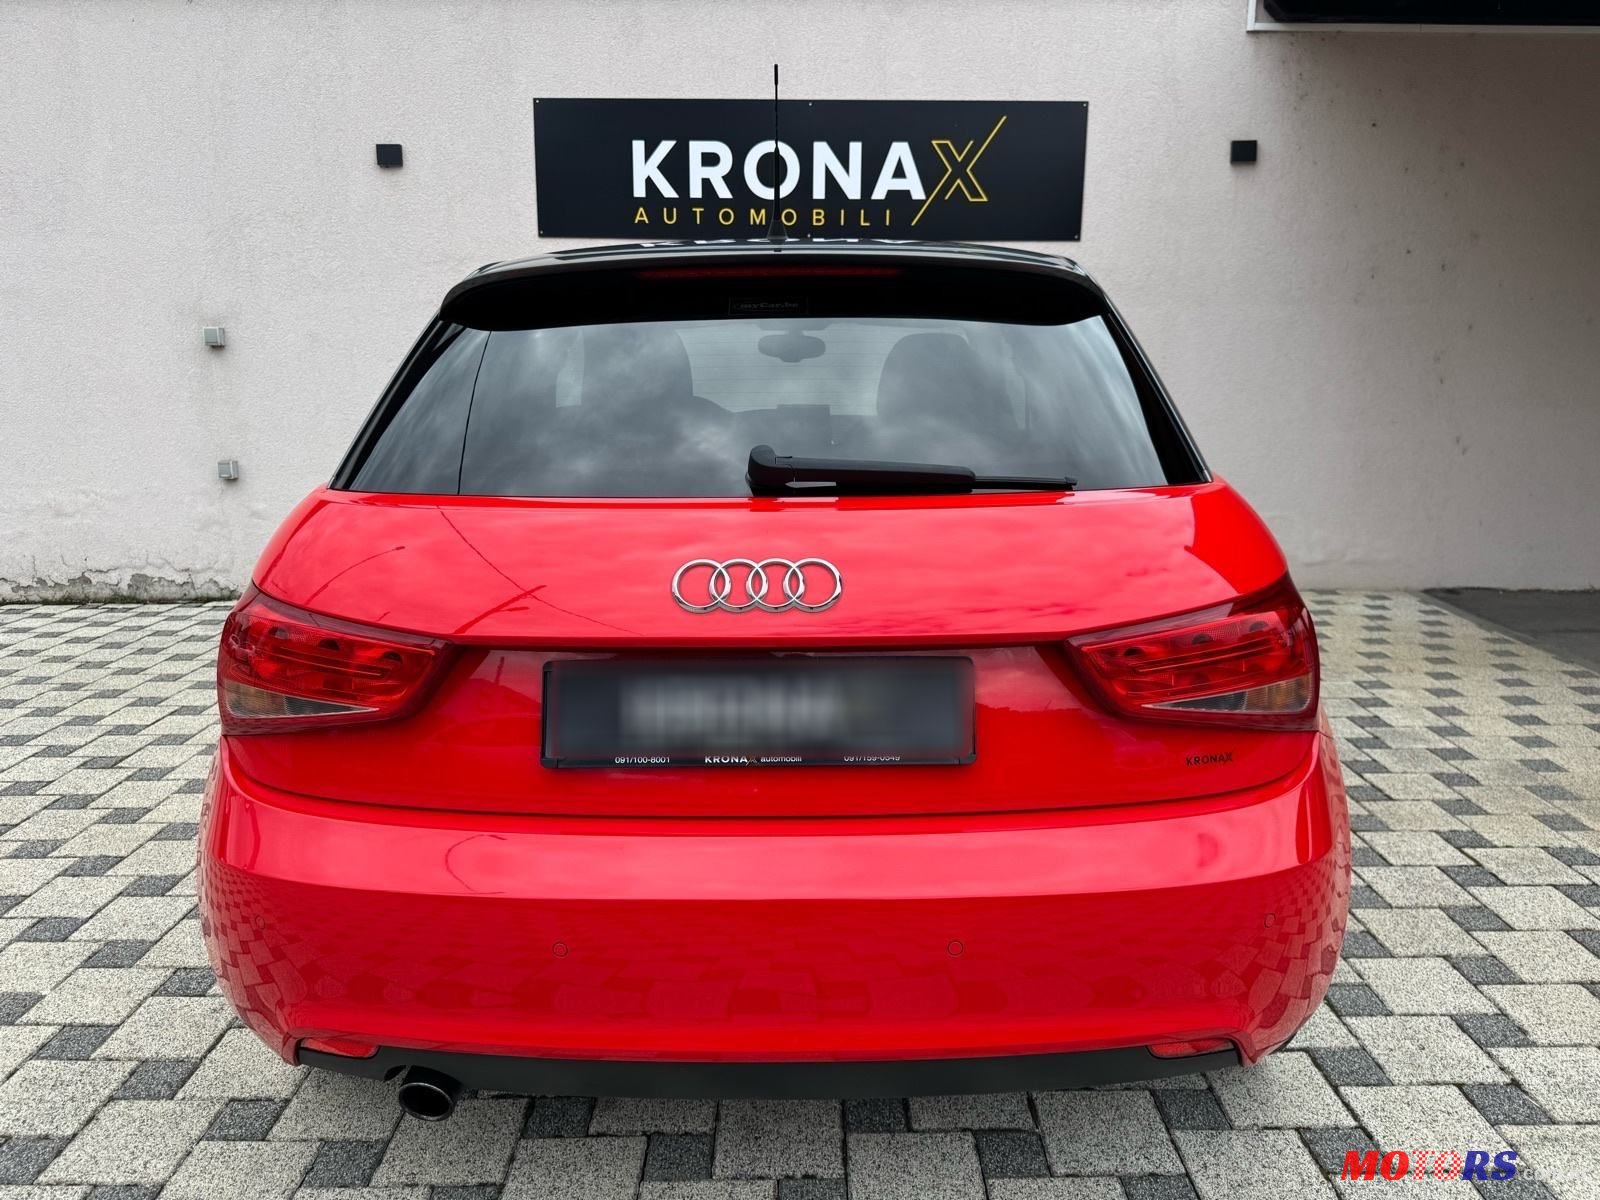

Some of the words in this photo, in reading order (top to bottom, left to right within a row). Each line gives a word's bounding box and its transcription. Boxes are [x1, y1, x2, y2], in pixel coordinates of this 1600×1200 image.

[631, 115, 1007, 226] KRONAX
[634, 207, 892, 227] AUTOMOBILI
[614, 755, 671, 764] 091/100-8001
[1185, 752, 1232, 767] KRONAX
